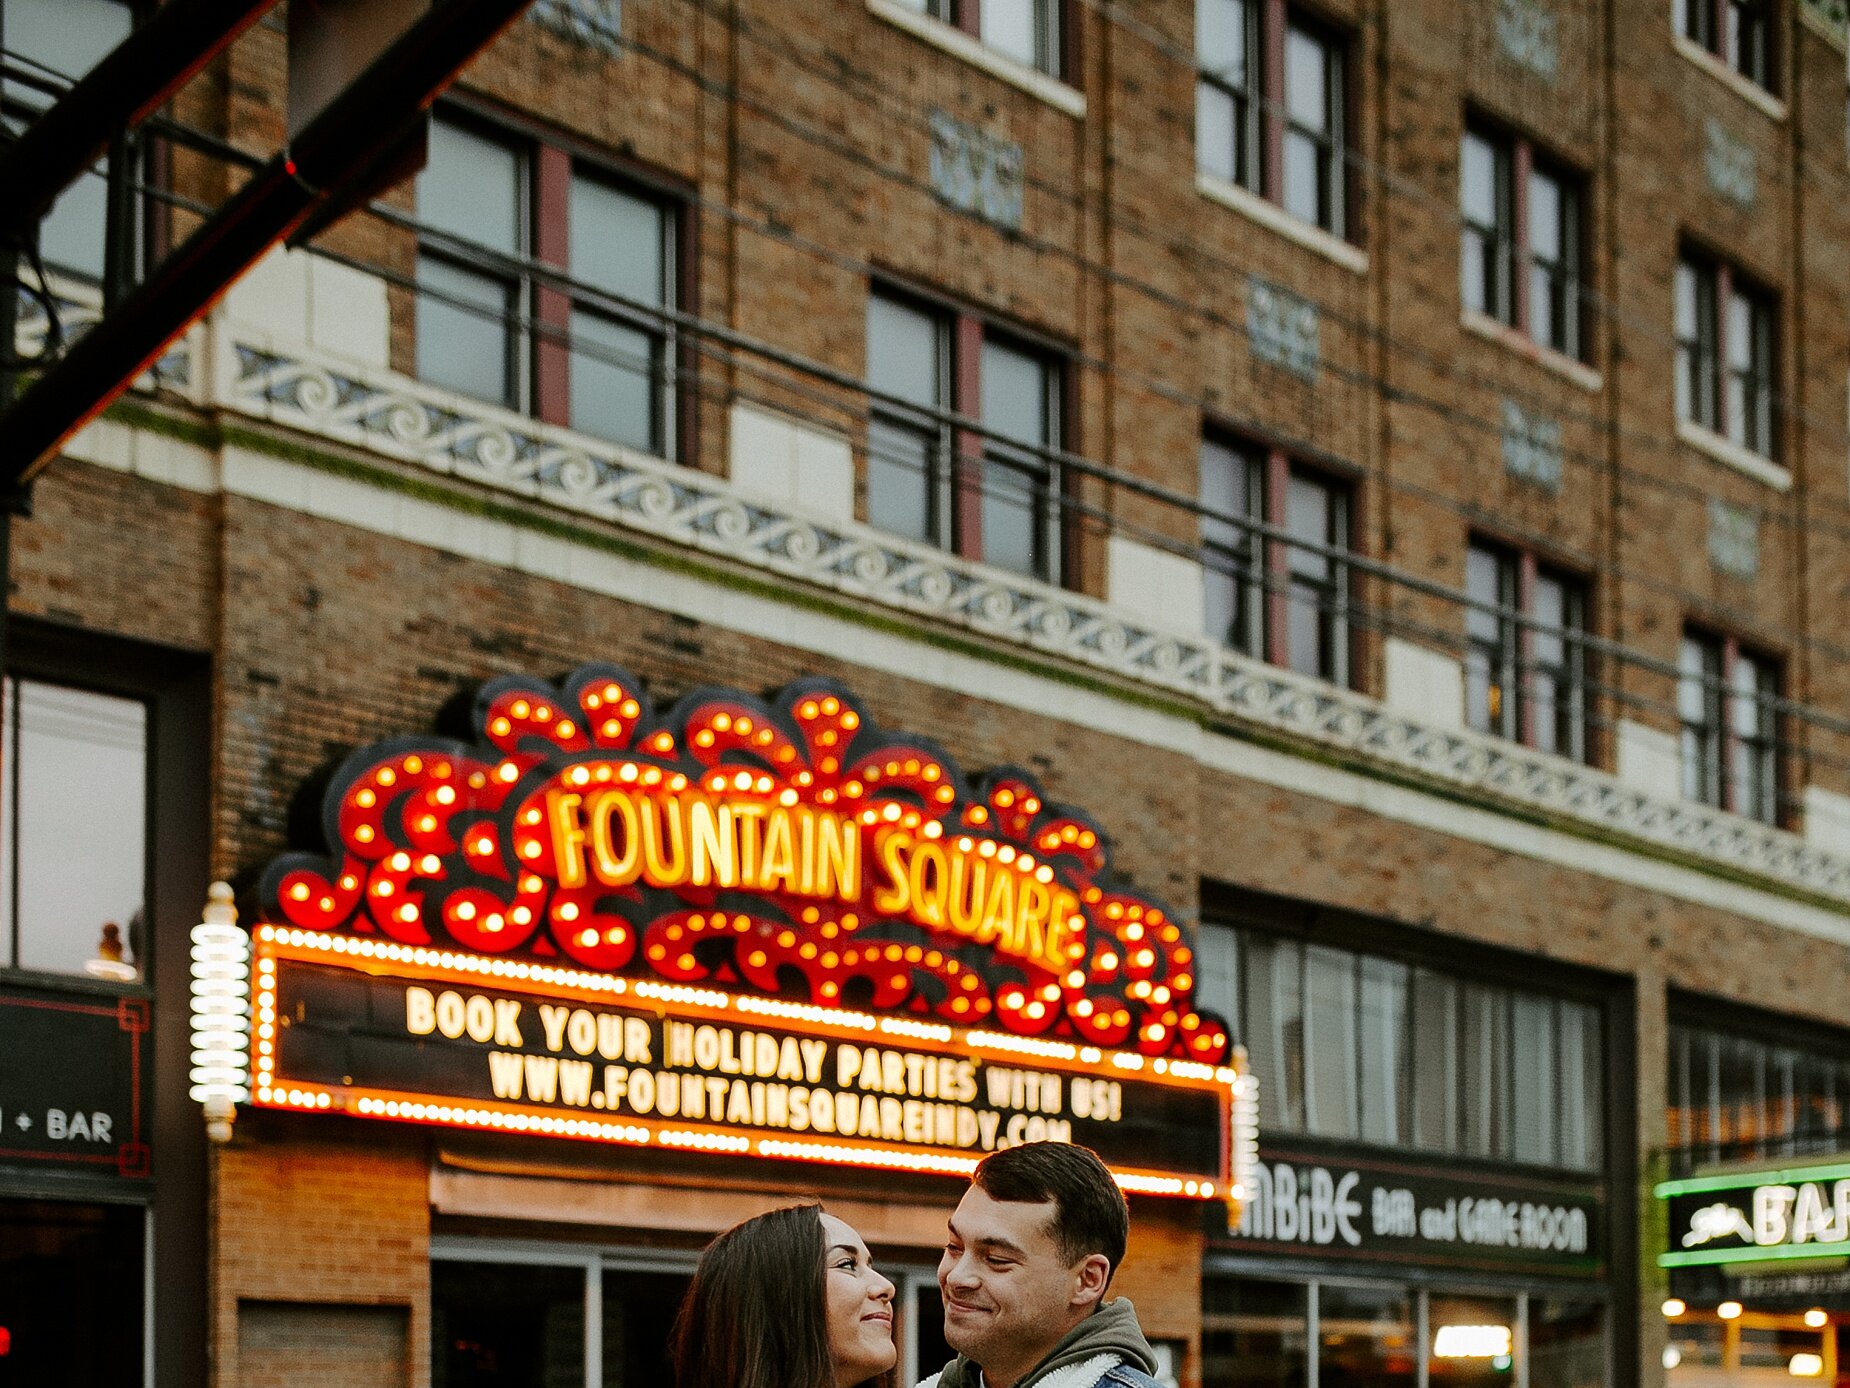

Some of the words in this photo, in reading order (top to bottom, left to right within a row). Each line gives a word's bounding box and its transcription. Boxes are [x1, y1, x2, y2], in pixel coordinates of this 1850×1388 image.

[549, 788, 861, 899] FOUNTAIN
[873, 828, 1081, 975] SQUARE
[406, 986, 523, 1048] BOOK
[538, 1004, 652, 1064] YOUR
[671, 1021, 827, 1084] HOLIDAY
[837, 1044, 978, 1103] PARTIES
[986, 1066, 1062, 1114] WITH
[1071, 1077, 1122, 1122] US!
[46, 1108, 113, 1144] BAR
